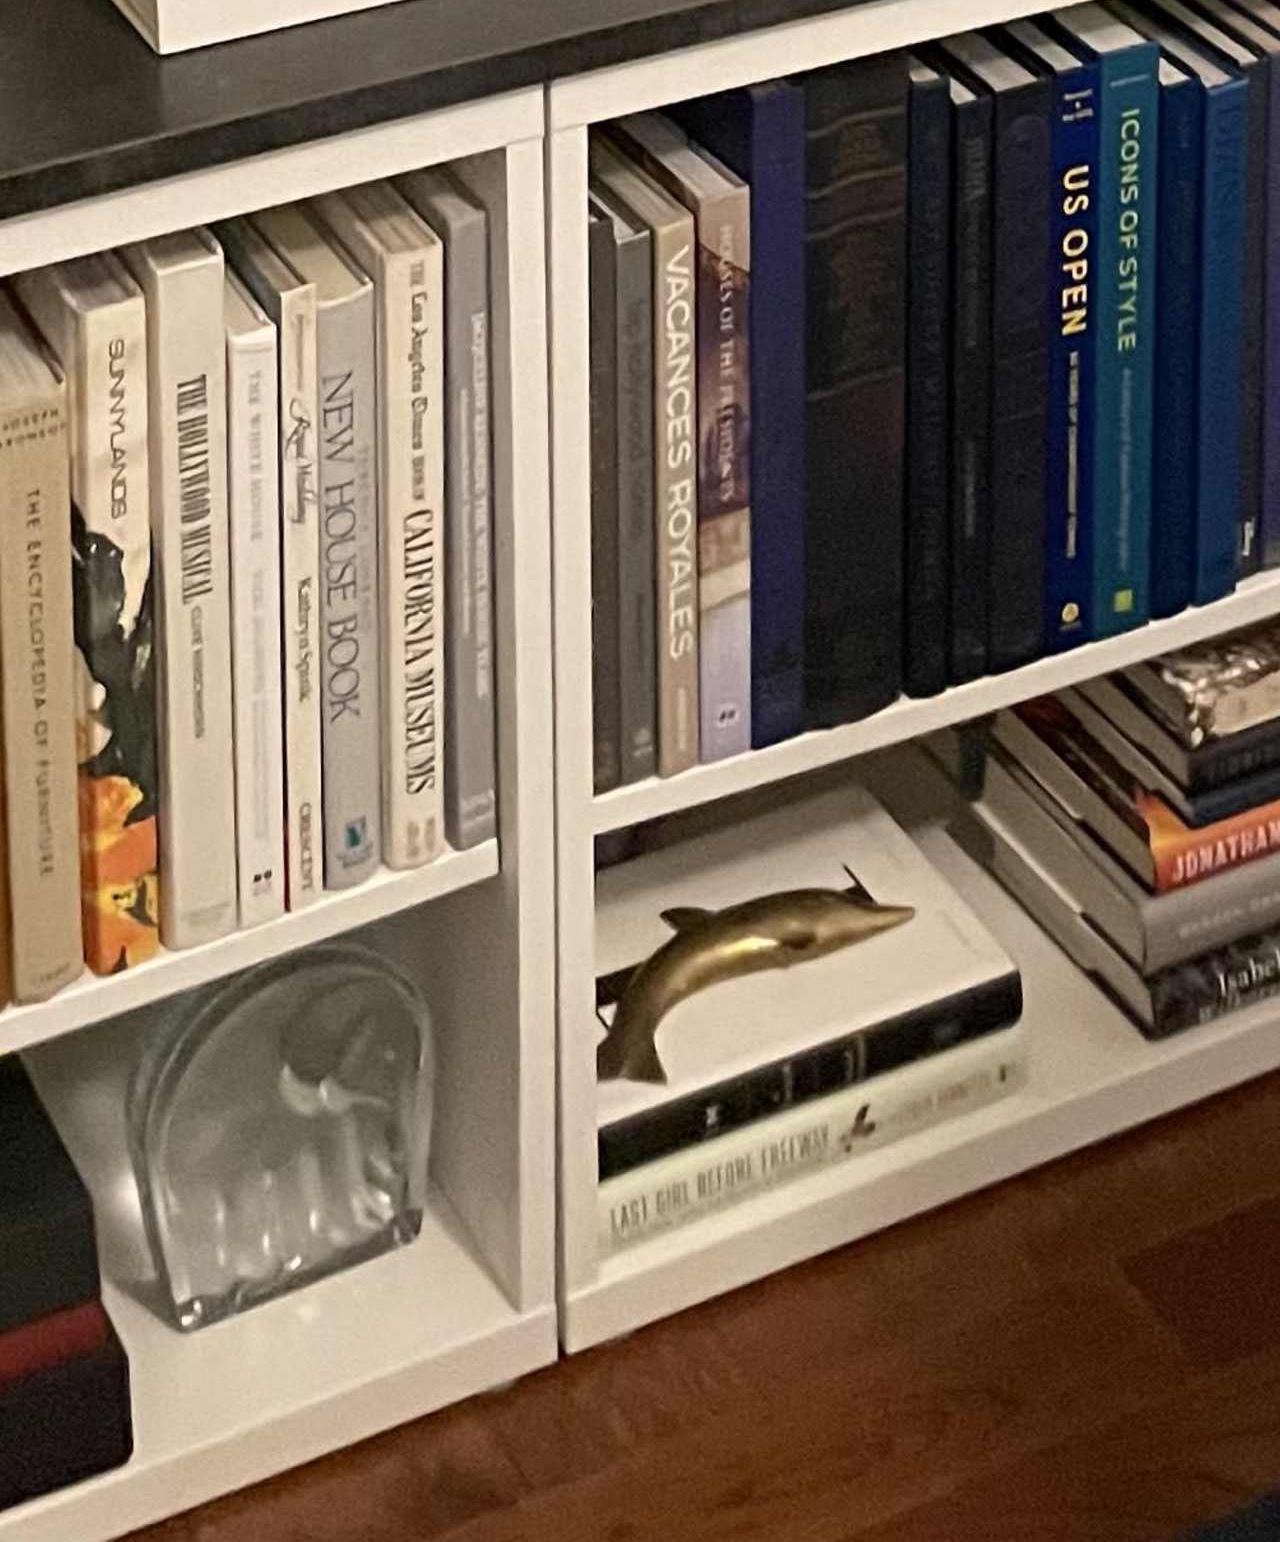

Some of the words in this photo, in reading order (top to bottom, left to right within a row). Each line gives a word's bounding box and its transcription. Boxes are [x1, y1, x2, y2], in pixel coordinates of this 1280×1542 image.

[1062, 165, 1089, 215] US
[1119, 107, 1140, 205] ICONS
[718, 225, 734, 302] HOUSES
[1119, 211, 1138, 249] OF
[720, 307, 735, 333] OF
[1061, 228, 1089, 337] OPEN
[1117, 254, 1138, 352] STYLE
[176, 374, 208, 414] THE
[665, 245, 692, 469] VACANCES
[720, 340, 735, 378] THE
[107, 337, 128, 521] SUNNYLANDS
[177, 413, 212, 524] HOLLYWOOD
[322, 371, 355, 465] NEW
[25, 489, 42, 529] THE
[325, 483, 357, 604] HOUSE
[181, 525, 214, 604] MUSICAL
[403, 508, 434, 666] CALIFORNIA
[668, 483, 694, 661] ROYALES
[26, 540, 48, 708] ENCYCLOPEDIA
[328, 615, 361, 723] BOOK
[34, 721, 50, 749] OF
[406, 673, 436, 796] MUSEUMS
[35, 760, 55, 878] FURNITURE
[609, 1200, 648, 1232] LAST
[655, 1183, 692, 1214] GIRL
[697, 1156, 753, 1197] BEFORE
[760, 1124, 831, 1173] FREEWAY
